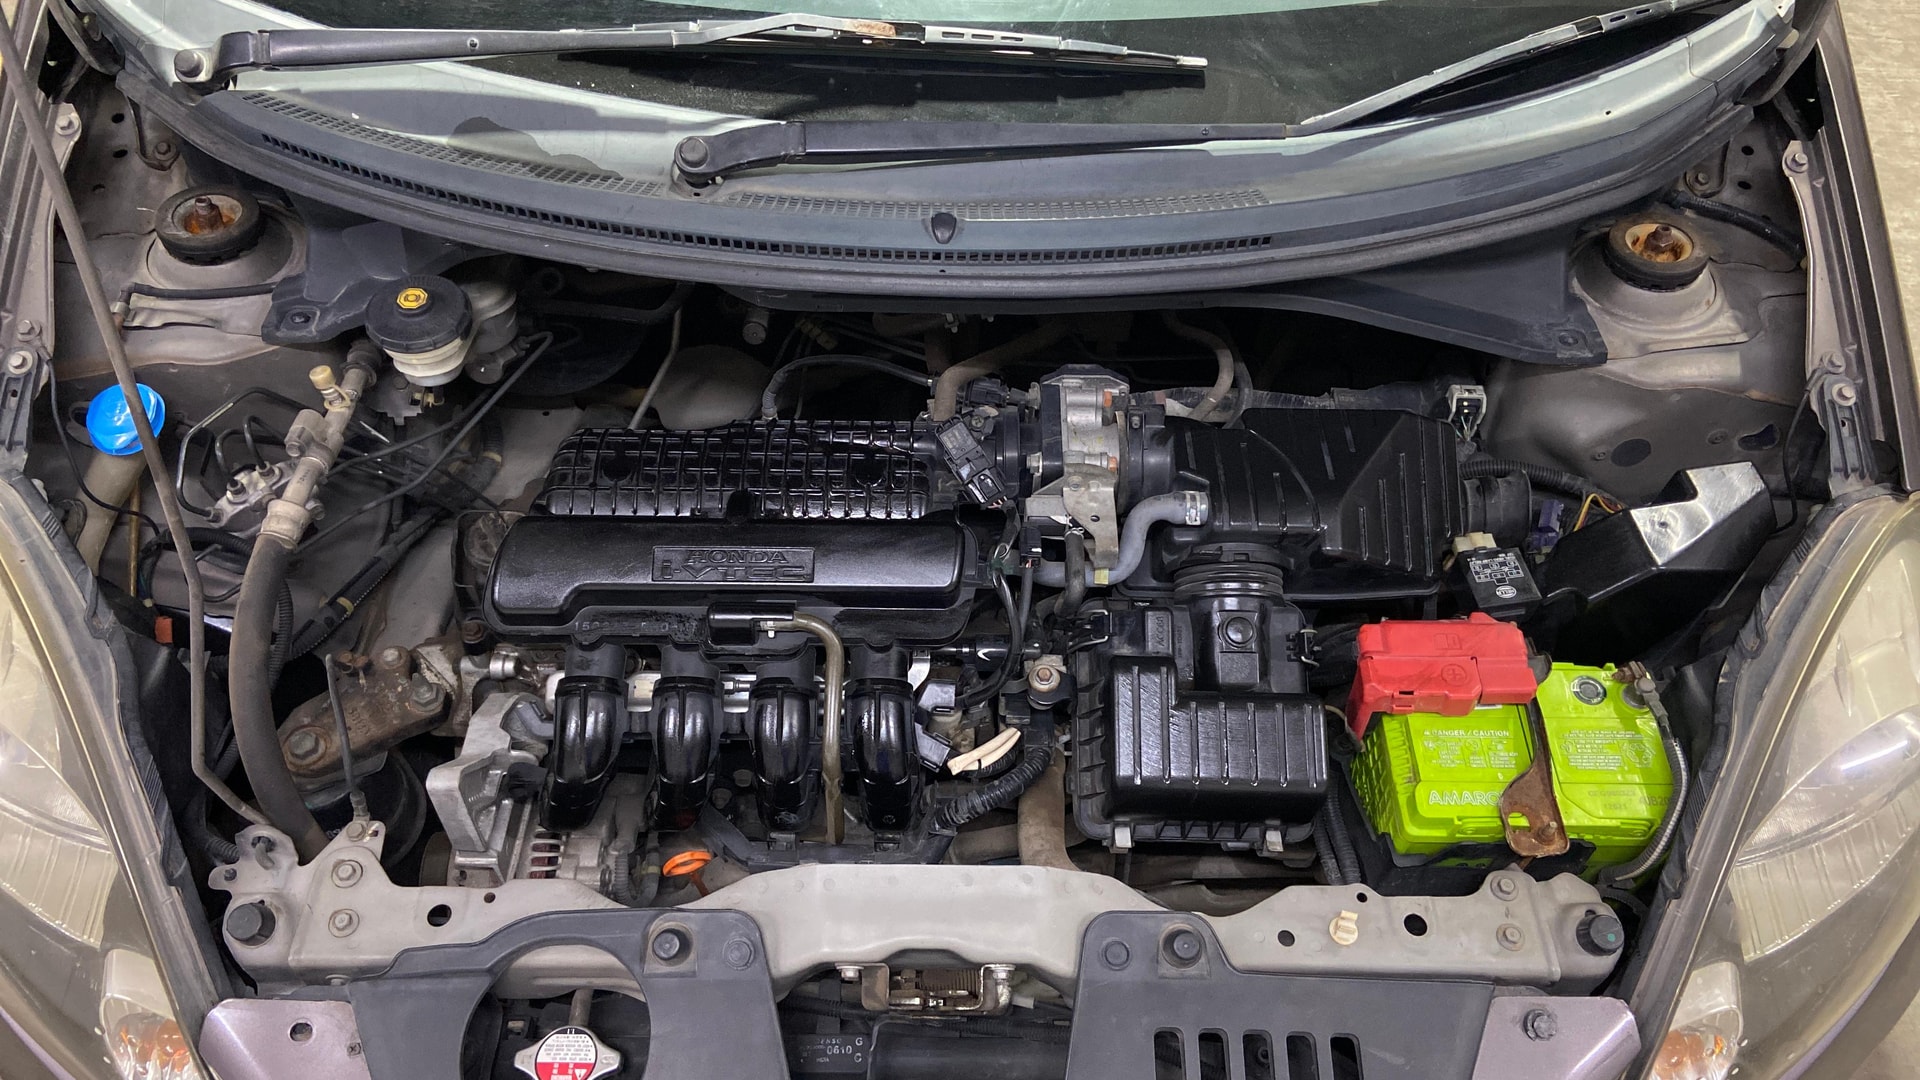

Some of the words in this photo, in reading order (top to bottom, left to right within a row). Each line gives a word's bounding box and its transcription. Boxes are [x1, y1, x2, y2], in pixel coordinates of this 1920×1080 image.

[687, 550, 789, 564] HONDA
[661, 560, 811, 581] i-VTEC
[1428, 790, 1503, 806] AMARO
[855, 1037, 863, 1046] G
[826, 1045, 852, 1055] 0610
